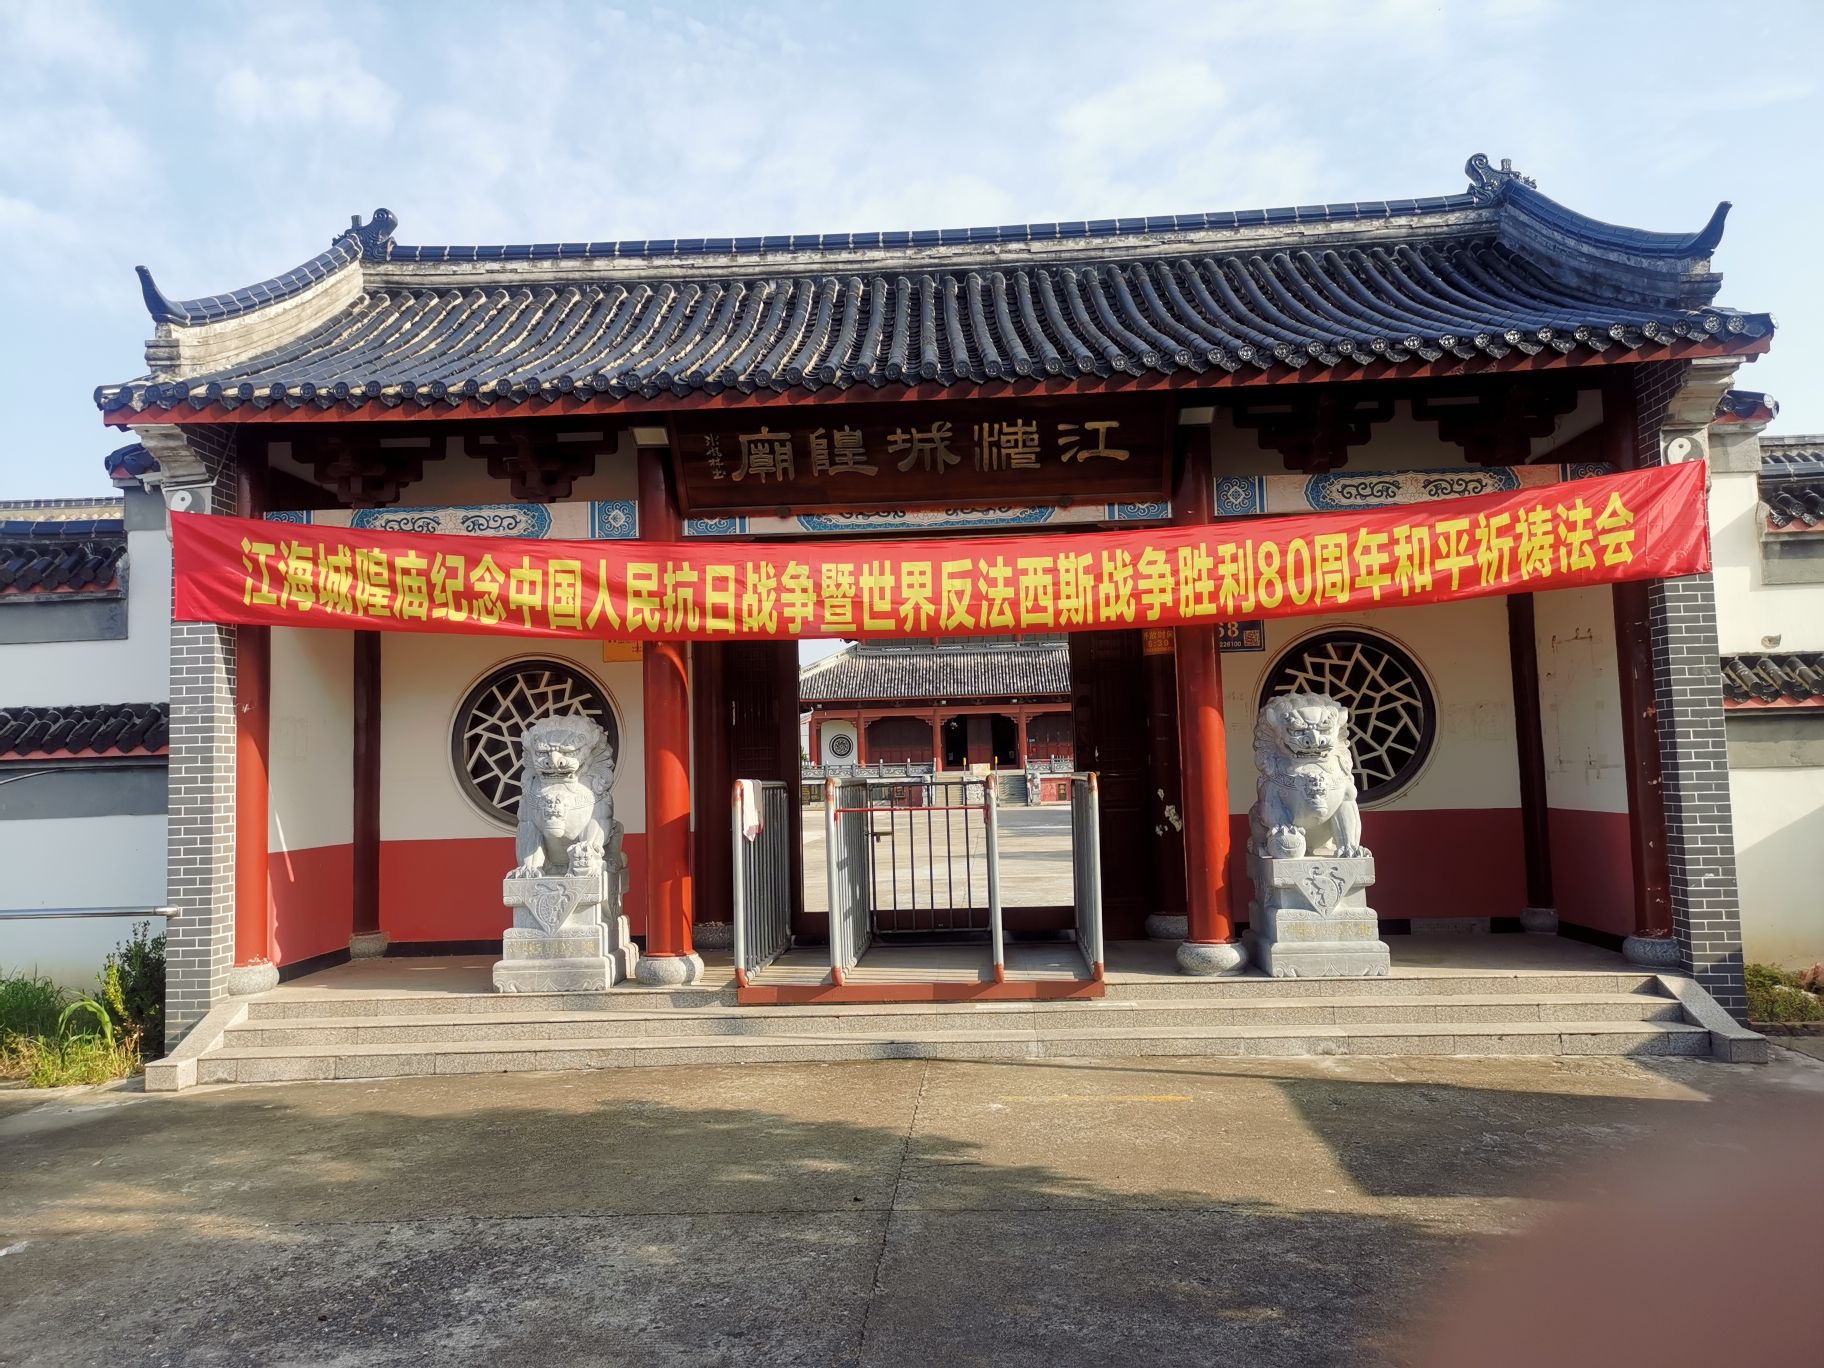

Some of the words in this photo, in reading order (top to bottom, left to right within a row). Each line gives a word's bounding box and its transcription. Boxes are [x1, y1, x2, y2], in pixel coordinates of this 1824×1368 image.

[241, 491, 1635, 634] 江海城隍庙纪念中国人民抗日战争暨世界反法西斯战争胜利80周年和平祈祷法会
